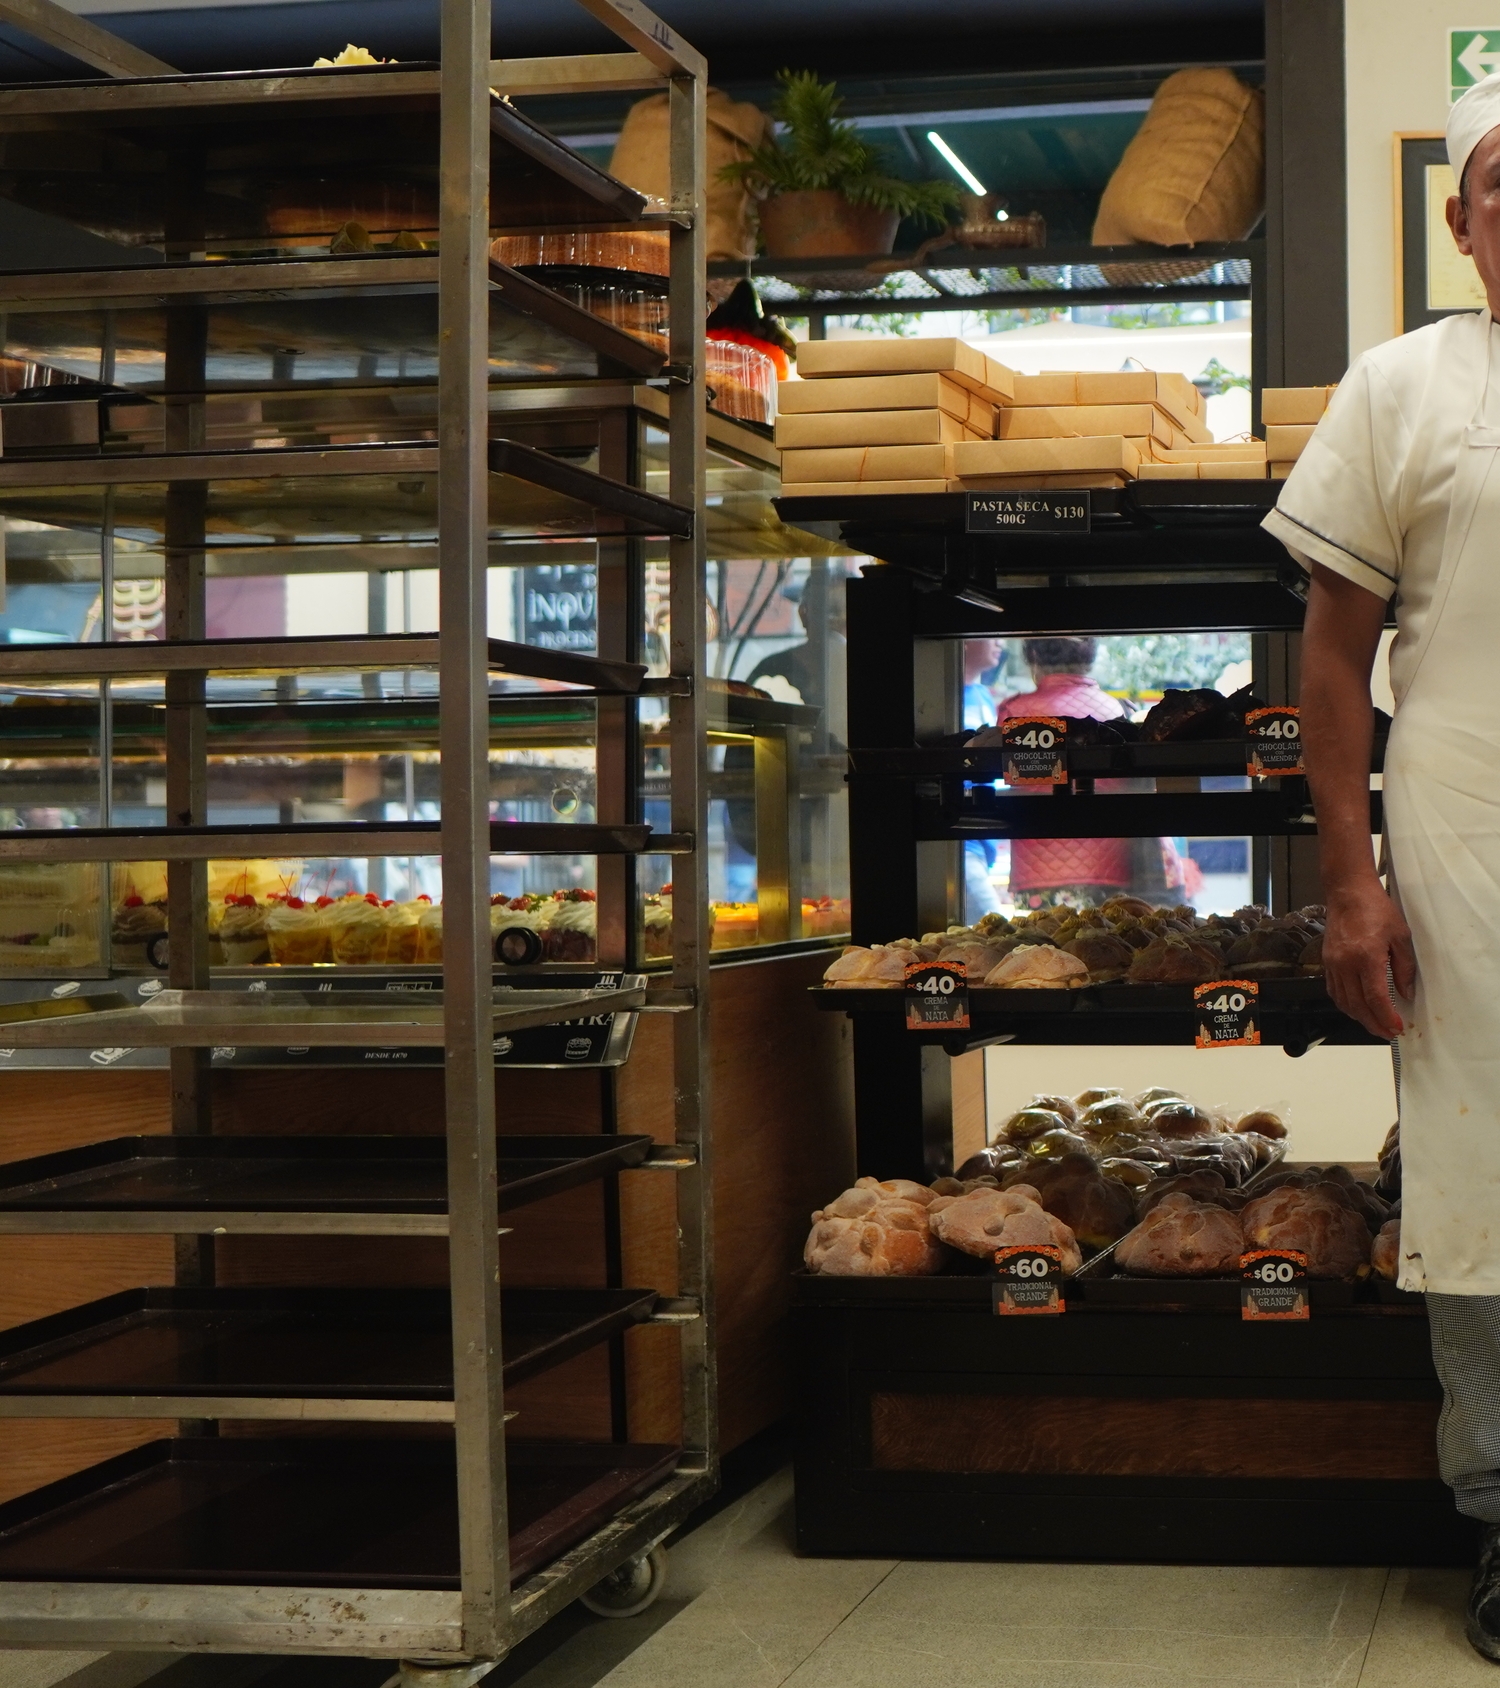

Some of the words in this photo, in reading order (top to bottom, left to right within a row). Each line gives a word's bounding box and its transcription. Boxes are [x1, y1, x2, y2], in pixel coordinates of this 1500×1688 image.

[973, 501, 1013, 512] PASTA
[1016, 501, 1050, 512] SECA
[1054, 506, 1085, 519] $130
[996, 514, 1026, 524] 500G
[1259, 720, 1299, 739] $40
[1015, 730, 1055, 748] $40
[1257, 742, 1301, 750] CHOCOLATE
[1013, 752, 1057, 760] CHOCOLATE
[916, 975, 955, 994] $40
[924, 996, 948, 1005] CREMA
[1206, 993, 1246, 1012] $40
[925, 1011, 949, 1021] NATA
[1213, 1014, 1239, 1023] CREMA
[1215, 1028, 1239, 1039] NATA
[1009, 1258, 1048, 1278] $60
[1254, 1263, 1294, 1283] $60
[1007, 1281, 1054, 1291] TRADICIONAL
[1014, 1291, 1049, 1301] GRANDE
[1250, 1287, 1298, 1296] TRADICIONAL
[1258, 1297, 1293, 1307] GRANDE
